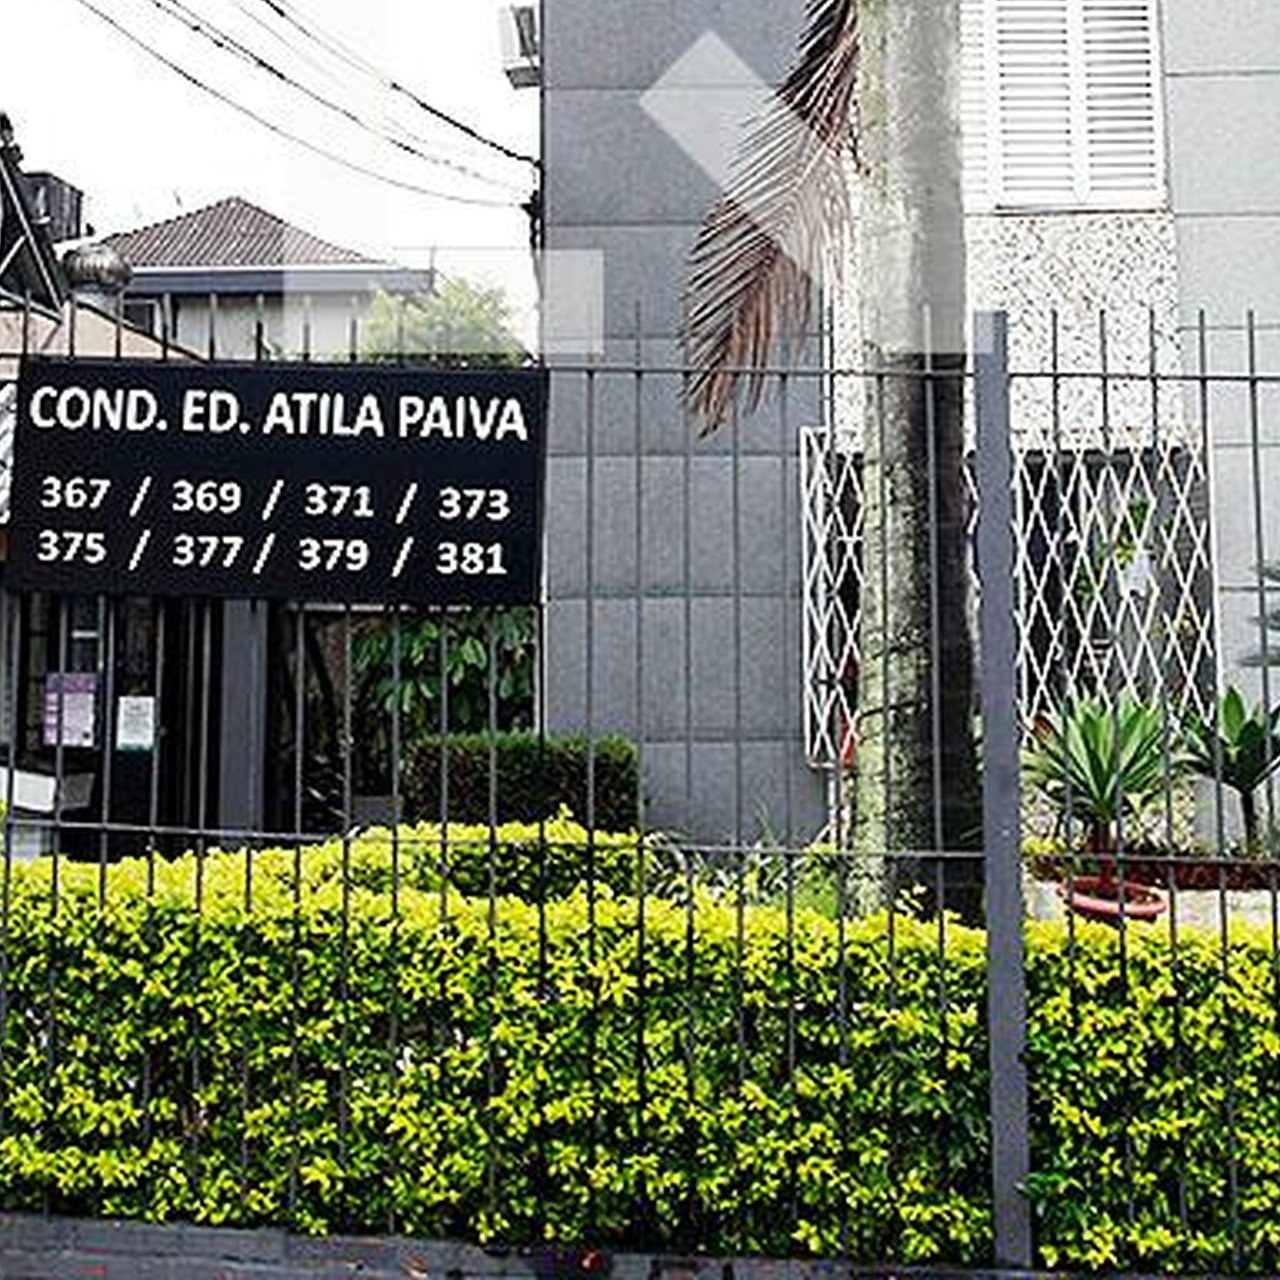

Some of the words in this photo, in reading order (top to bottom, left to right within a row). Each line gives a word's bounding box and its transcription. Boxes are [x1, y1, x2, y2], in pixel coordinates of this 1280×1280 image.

[29, 386, 168, 432] COND.
[182, 389, 251, 435] ED.
[262, 392, 385, 438] ATILA
[399, 395, 528, 441] PAIVA
[40, 476, 111, 510] 367
[129, 475, 152, 517] /
[172, 479, 241, 514] 369
[262, 479, 285, 521] /
[304, 483, 374, 519] 371
[395, 482, 418, 524] /
[439, 486, 511, 521] 373
[37, 529, 107, 565] 375
[128, 529, 151, 571] /
[172, 533, 244, 569] 377
[252, 532, 276, 575] /
[298, 537, 369, 572] 379
[391, 536, 414, 578] /
[436, 542, 508, 576] 381
